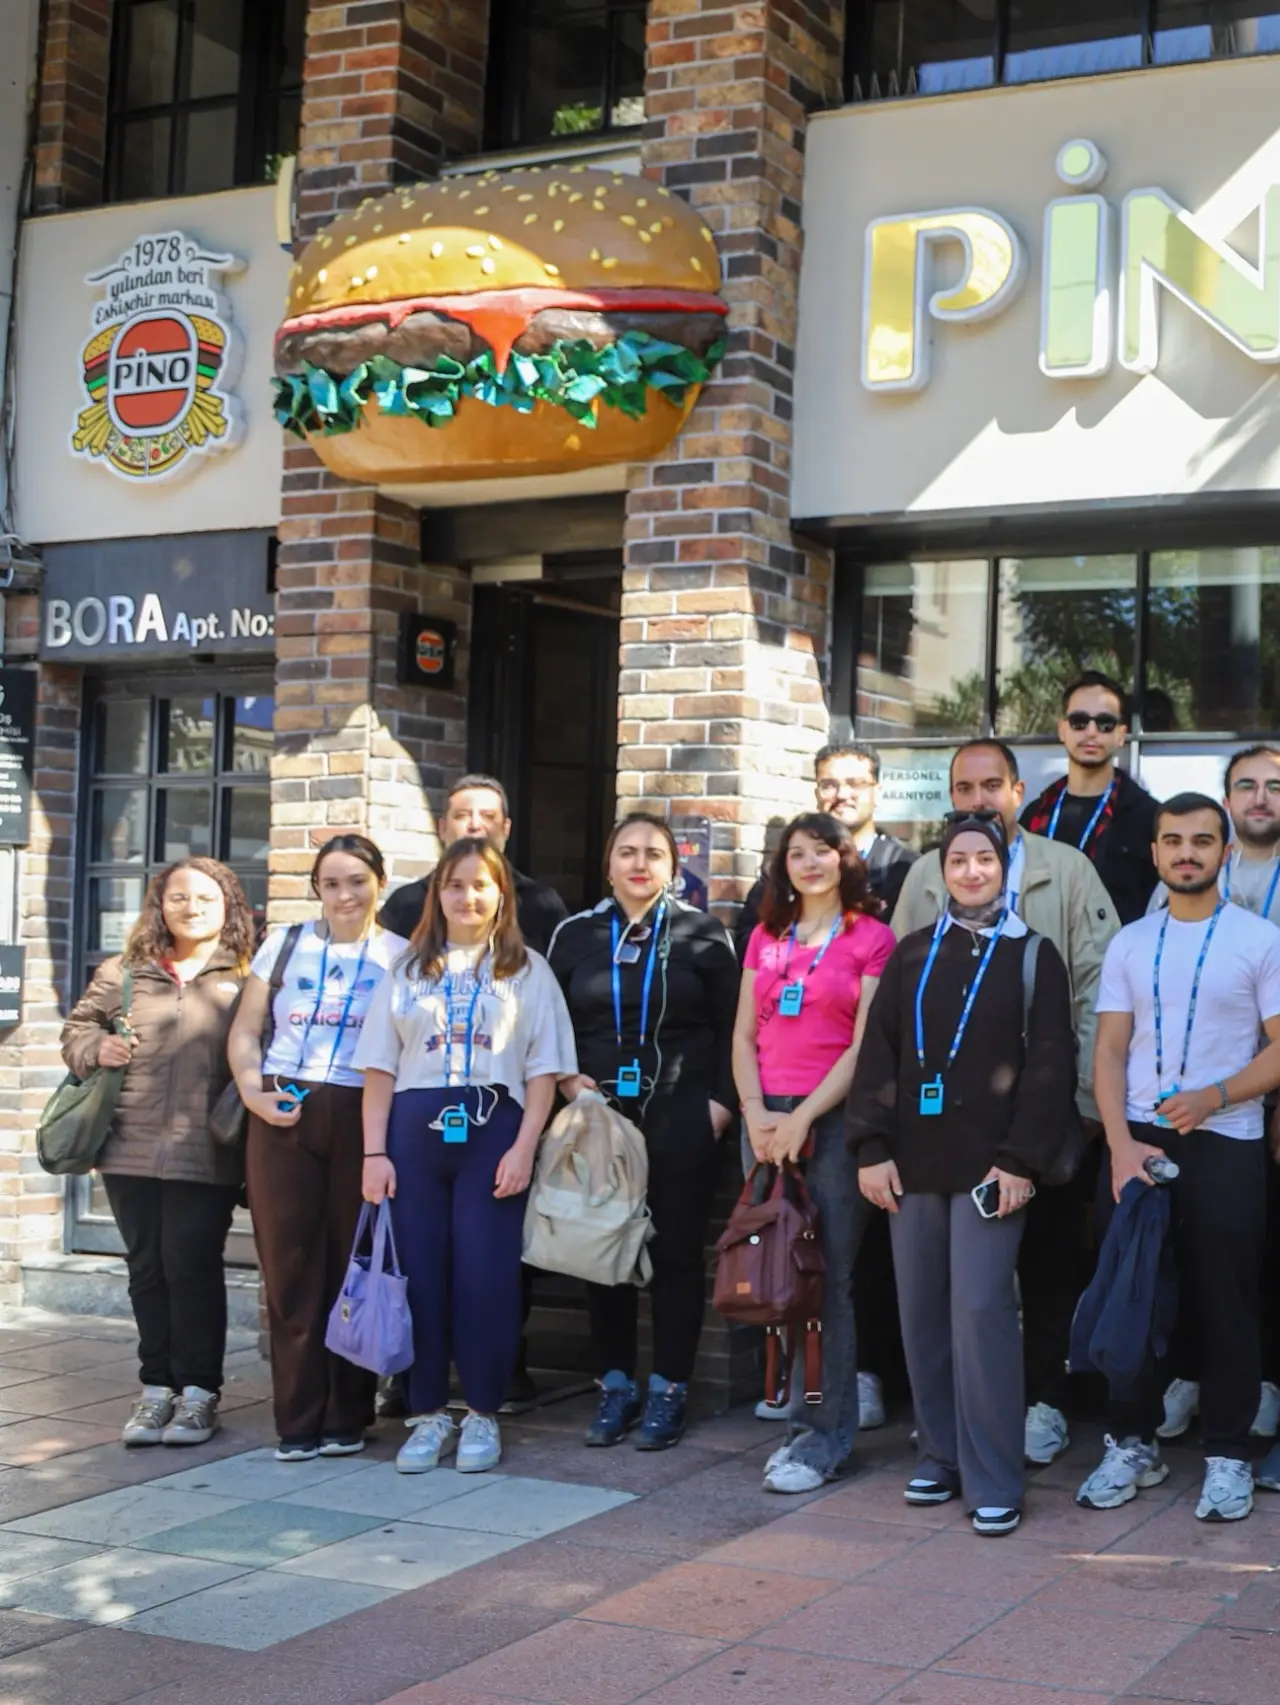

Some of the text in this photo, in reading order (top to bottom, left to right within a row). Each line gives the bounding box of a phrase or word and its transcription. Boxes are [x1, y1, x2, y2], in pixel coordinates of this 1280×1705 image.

[134, 236, 182, 267] 1978
[177, 266, 205, 286] beri
[46, 593, 275, 648] BORA Apt. No:
[882, 770, 943, 781] PERSONEL
[881, 791, 942, 802] ARANIYOR
